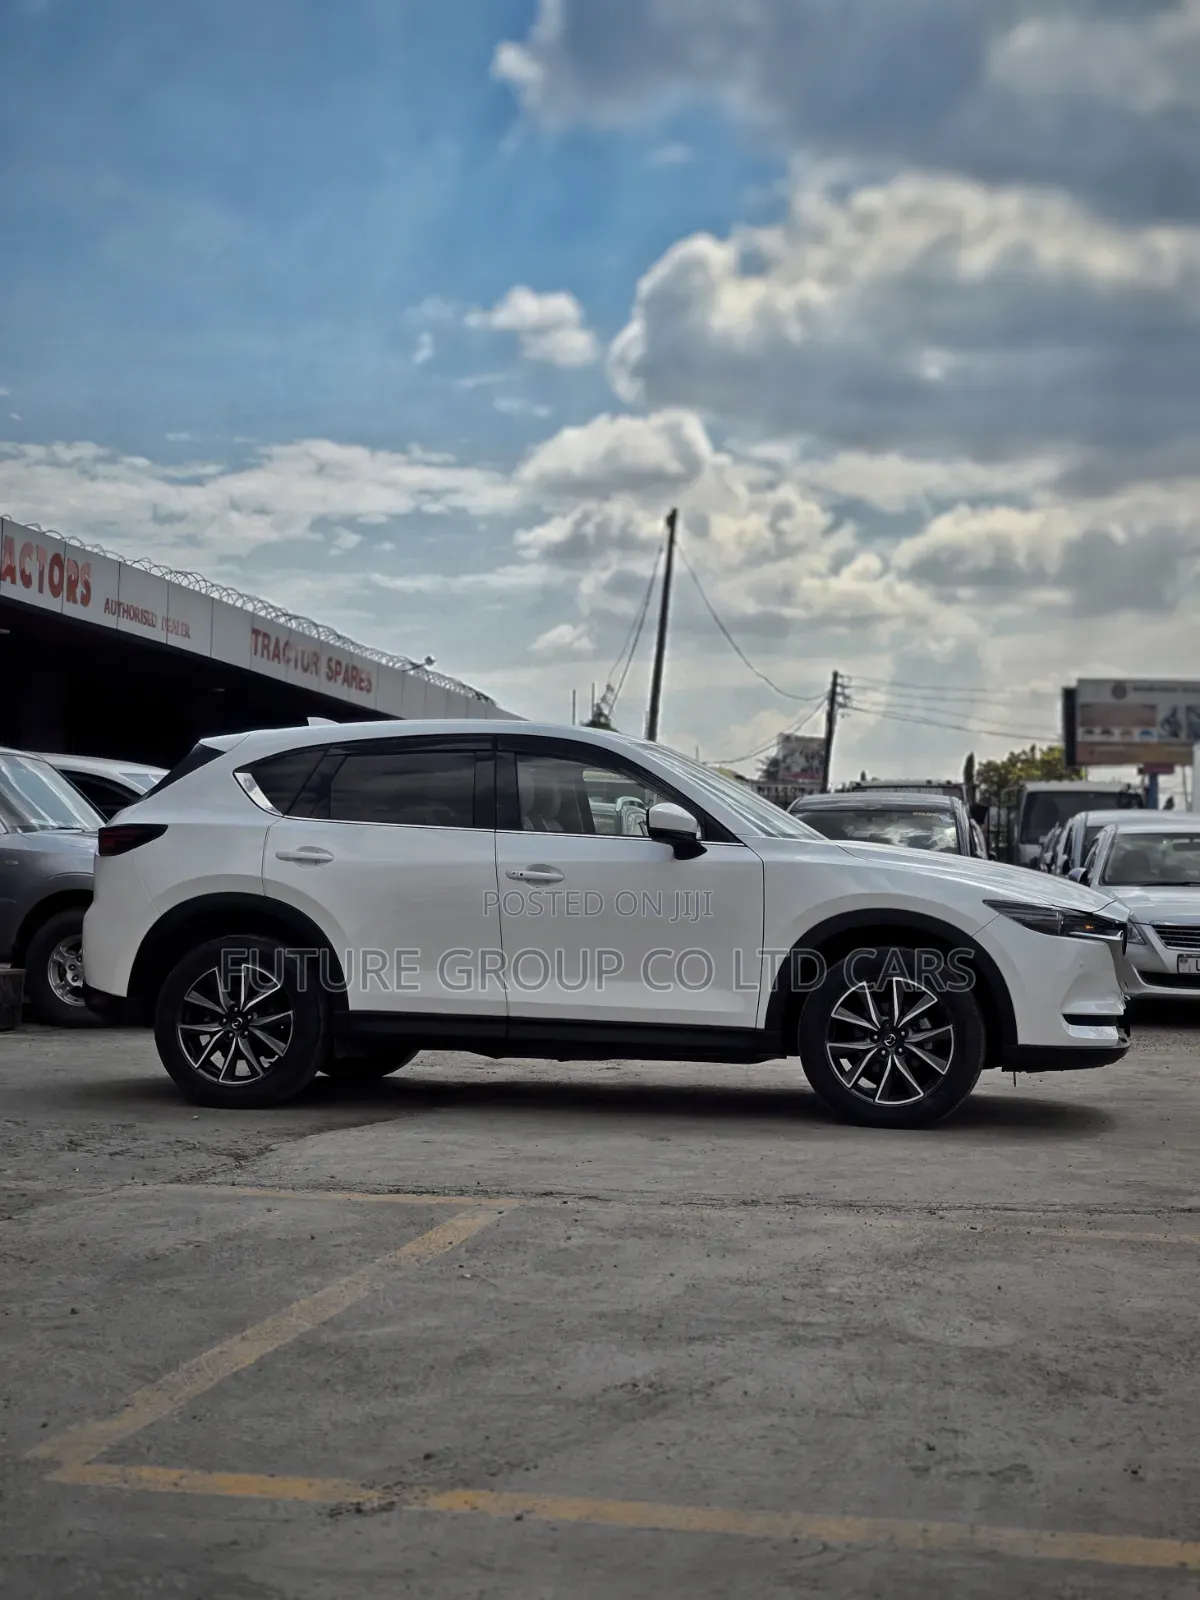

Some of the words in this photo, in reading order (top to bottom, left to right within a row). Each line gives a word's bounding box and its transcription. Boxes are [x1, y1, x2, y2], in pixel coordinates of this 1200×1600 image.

[1, 534, 92, 607] ACTORS
[104, 597, 157, 628] AUTHORISED
[251, 627, 319, 676] TRACTOR
[326, 656, 373, 693] SPARES
